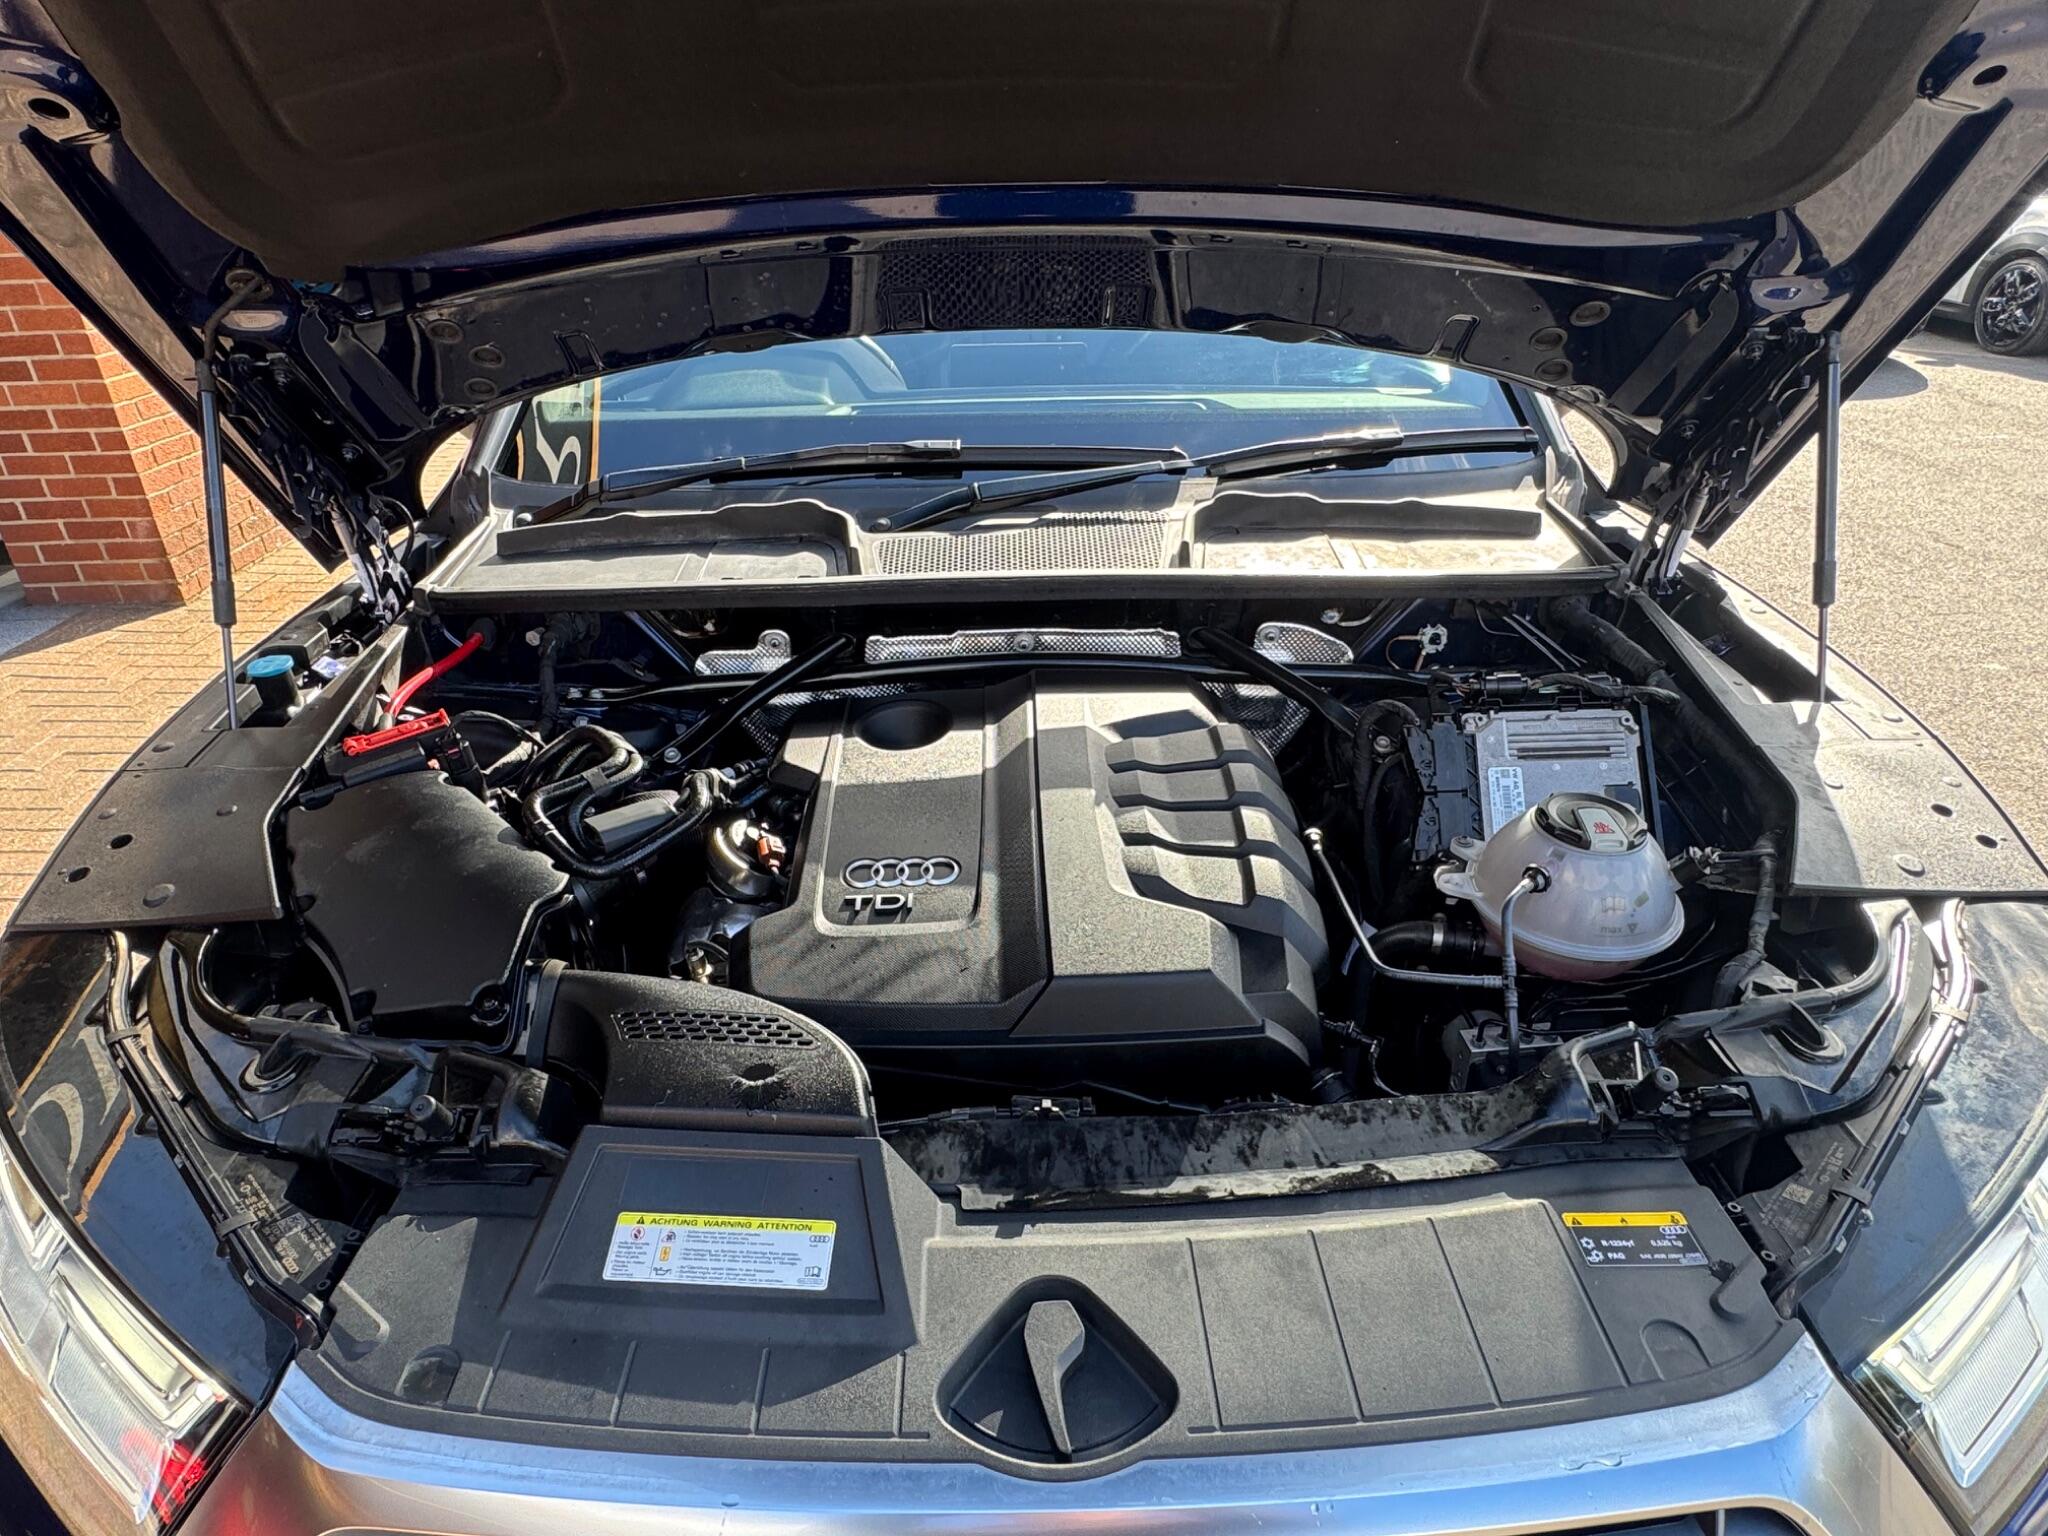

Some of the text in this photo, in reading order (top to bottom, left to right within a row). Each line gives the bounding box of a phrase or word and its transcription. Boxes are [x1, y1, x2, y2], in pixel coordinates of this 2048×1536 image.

[845, 892, 914, 911] TDI
[1600, 926, 1622, 934] max
[649, 1217, 813, 1231] ACHTUNG WARNING ATTENTION
